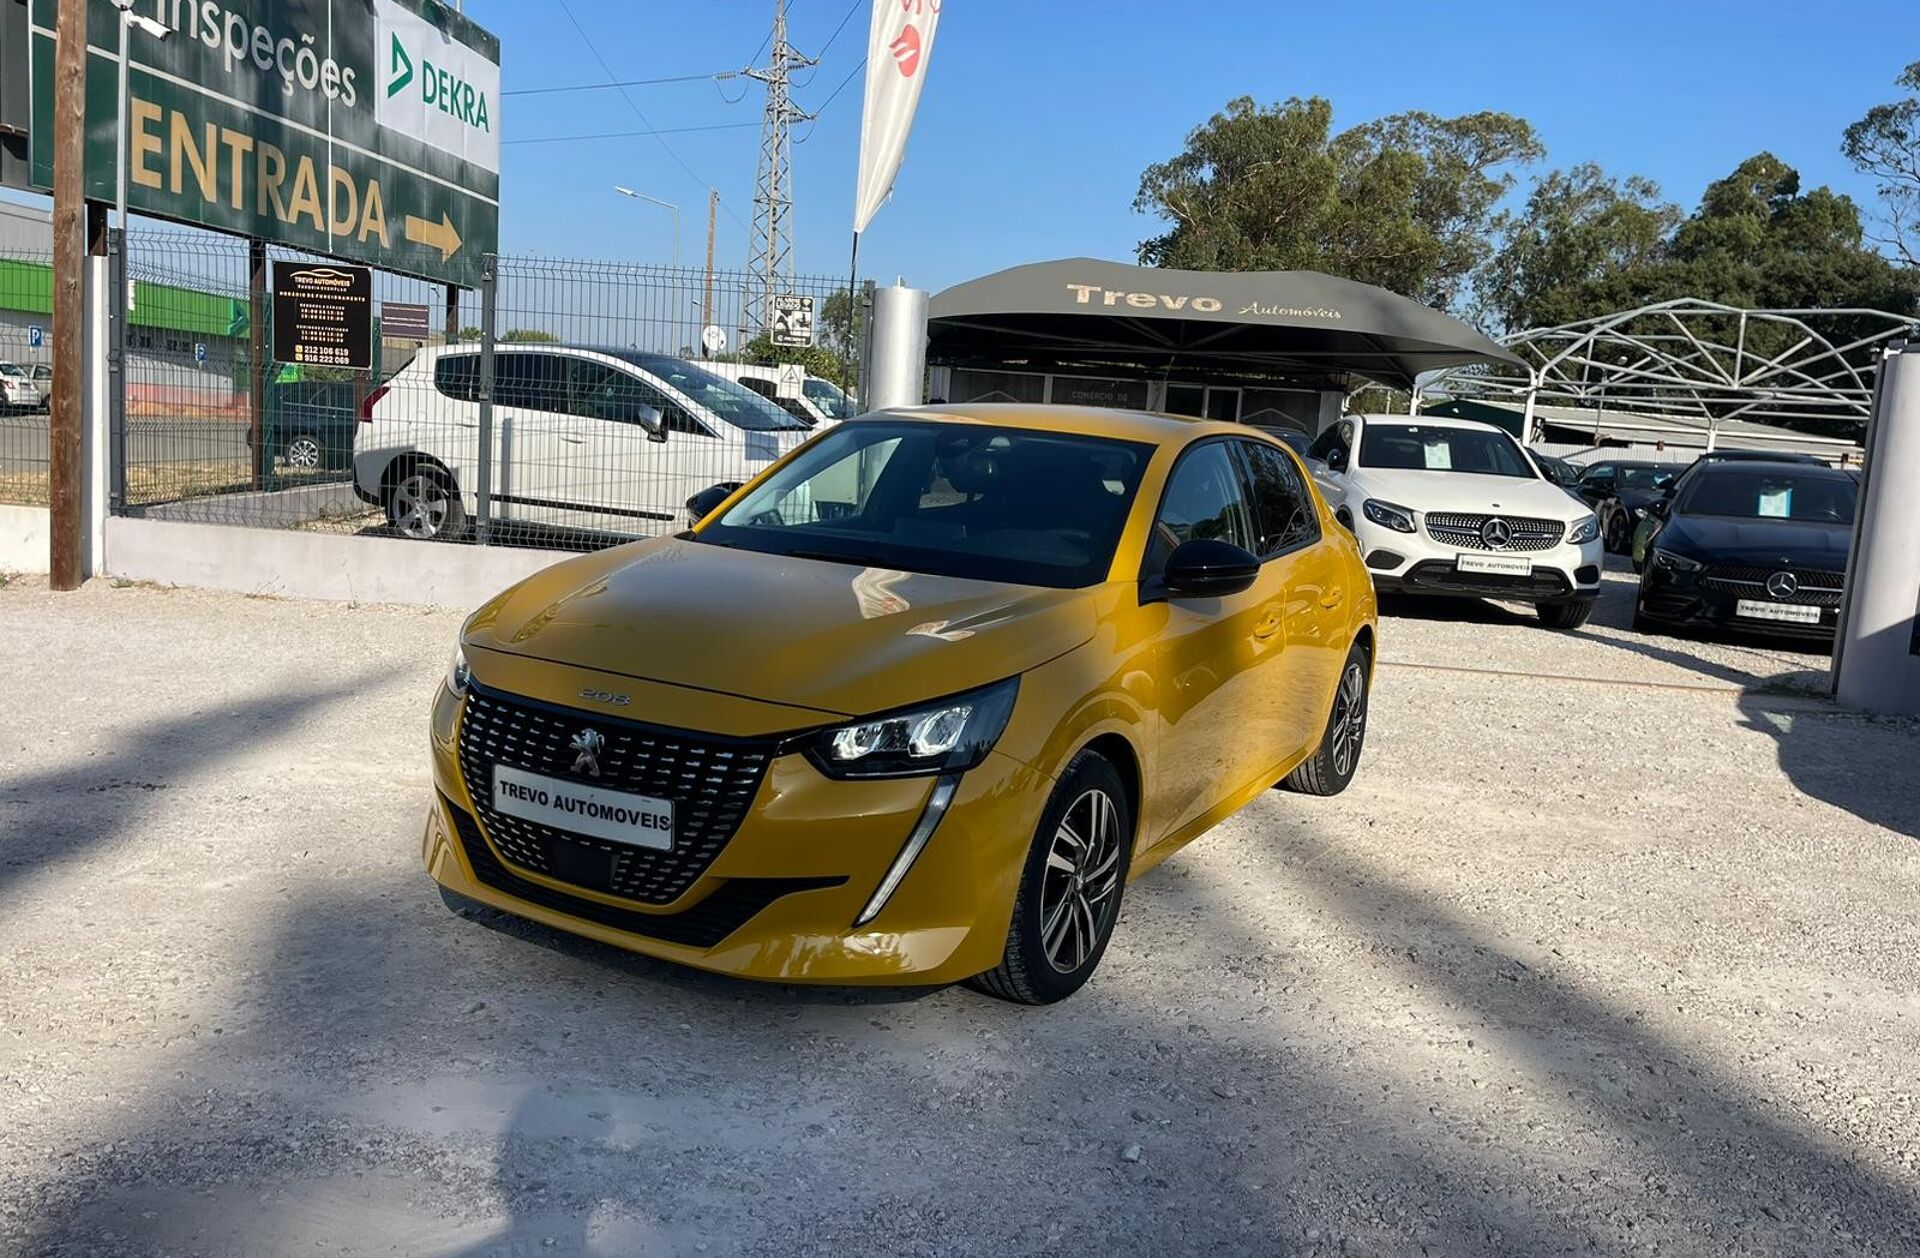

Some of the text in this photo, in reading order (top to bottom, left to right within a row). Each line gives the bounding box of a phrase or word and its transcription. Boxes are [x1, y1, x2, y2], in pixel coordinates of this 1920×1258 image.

[422, 60, 490, 133] DEKRA
[131, 97, 390, 249] ENTRADA
[1066, 283, 1342, 320] Trevo Automóveis
[304, 345, 319, 355] 212
[1462, 560, 1484, 568] TREVO
[1740, 605, 1766, 613] TREVO
[499, 780, 672, 832] TREVO AUTOMOVEIS
